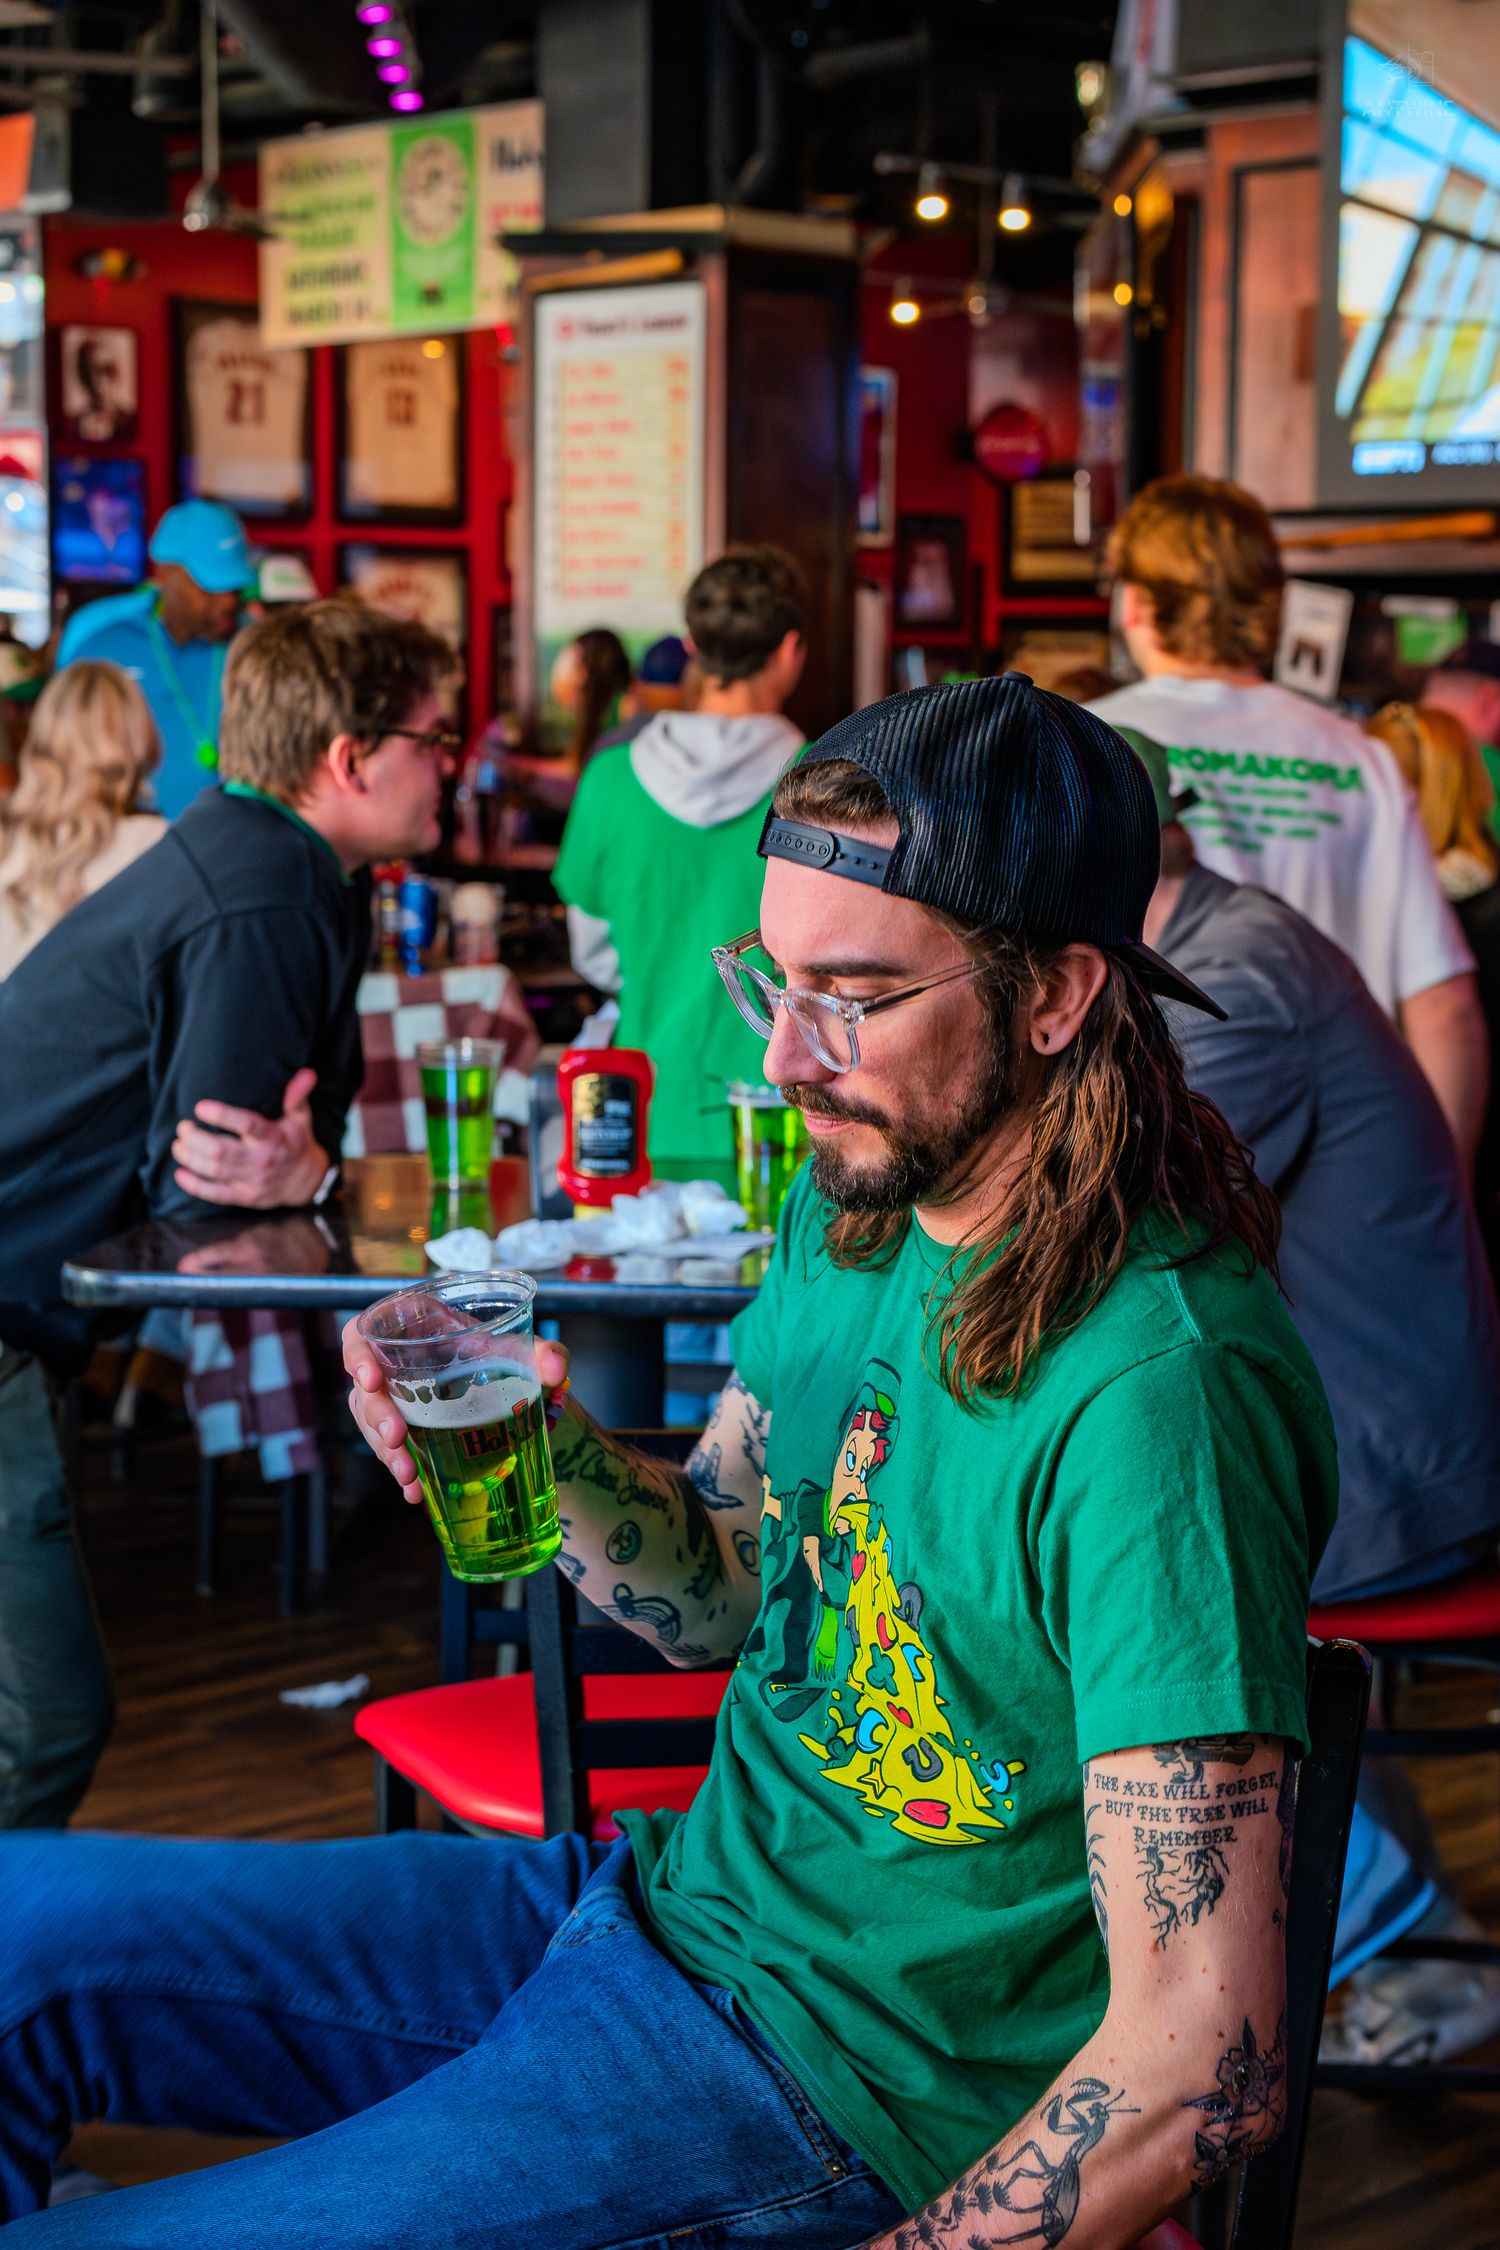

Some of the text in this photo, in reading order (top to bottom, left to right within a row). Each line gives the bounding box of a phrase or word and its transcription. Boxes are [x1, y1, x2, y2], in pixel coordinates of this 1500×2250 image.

[1094, 1773, 1119, 1792] THE
[1122, 1780, 1159, 1799] AXE
[1163, 1783, 1210, 1800] WILL
[1105, 1798, 1269, 1824] BUT THE TREE WILL
[1133, 1825, 1238, 1847] REMEMBER
